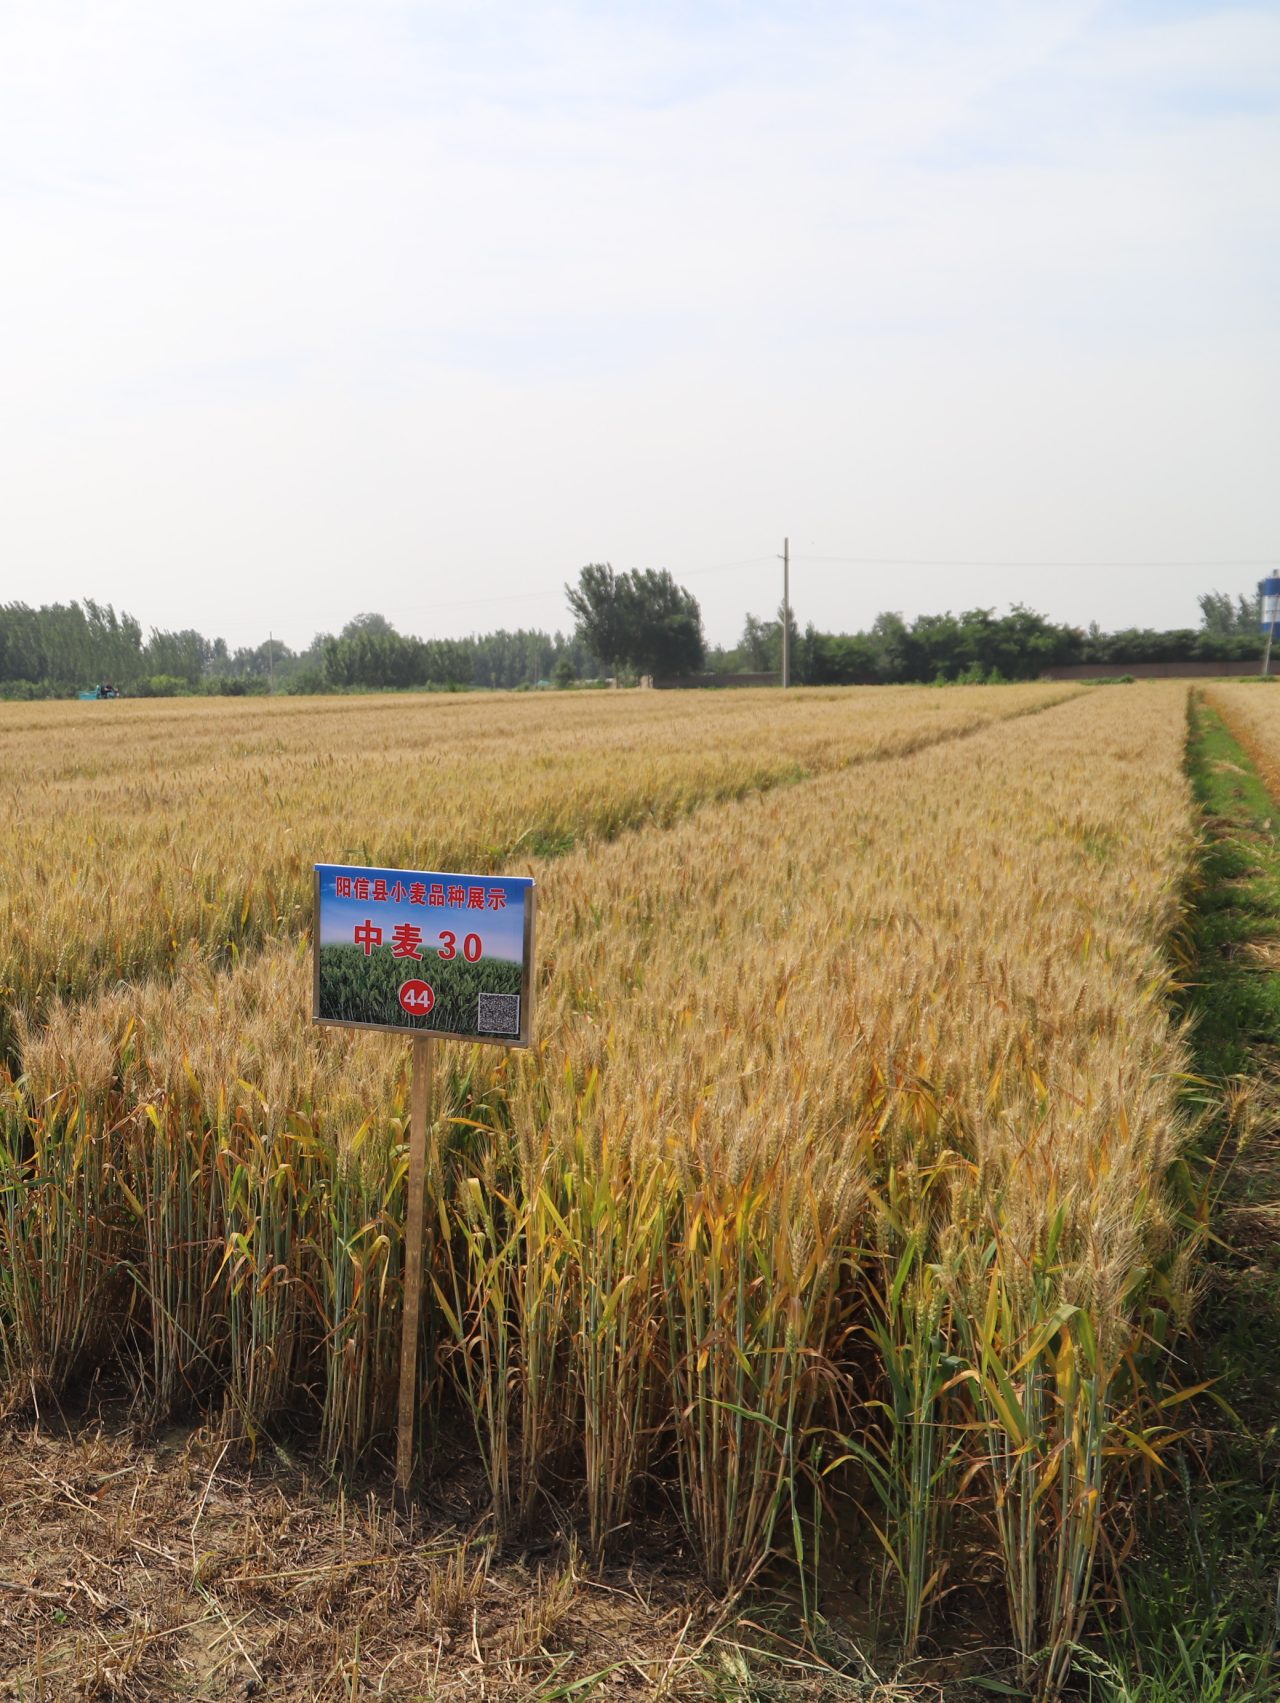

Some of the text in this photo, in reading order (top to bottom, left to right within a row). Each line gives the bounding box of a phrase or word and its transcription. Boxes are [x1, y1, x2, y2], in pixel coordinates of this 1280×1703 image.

[335, 876, 508, 911] 阳信县小麦品种展示
[403, 989, 431, 1007] 44
